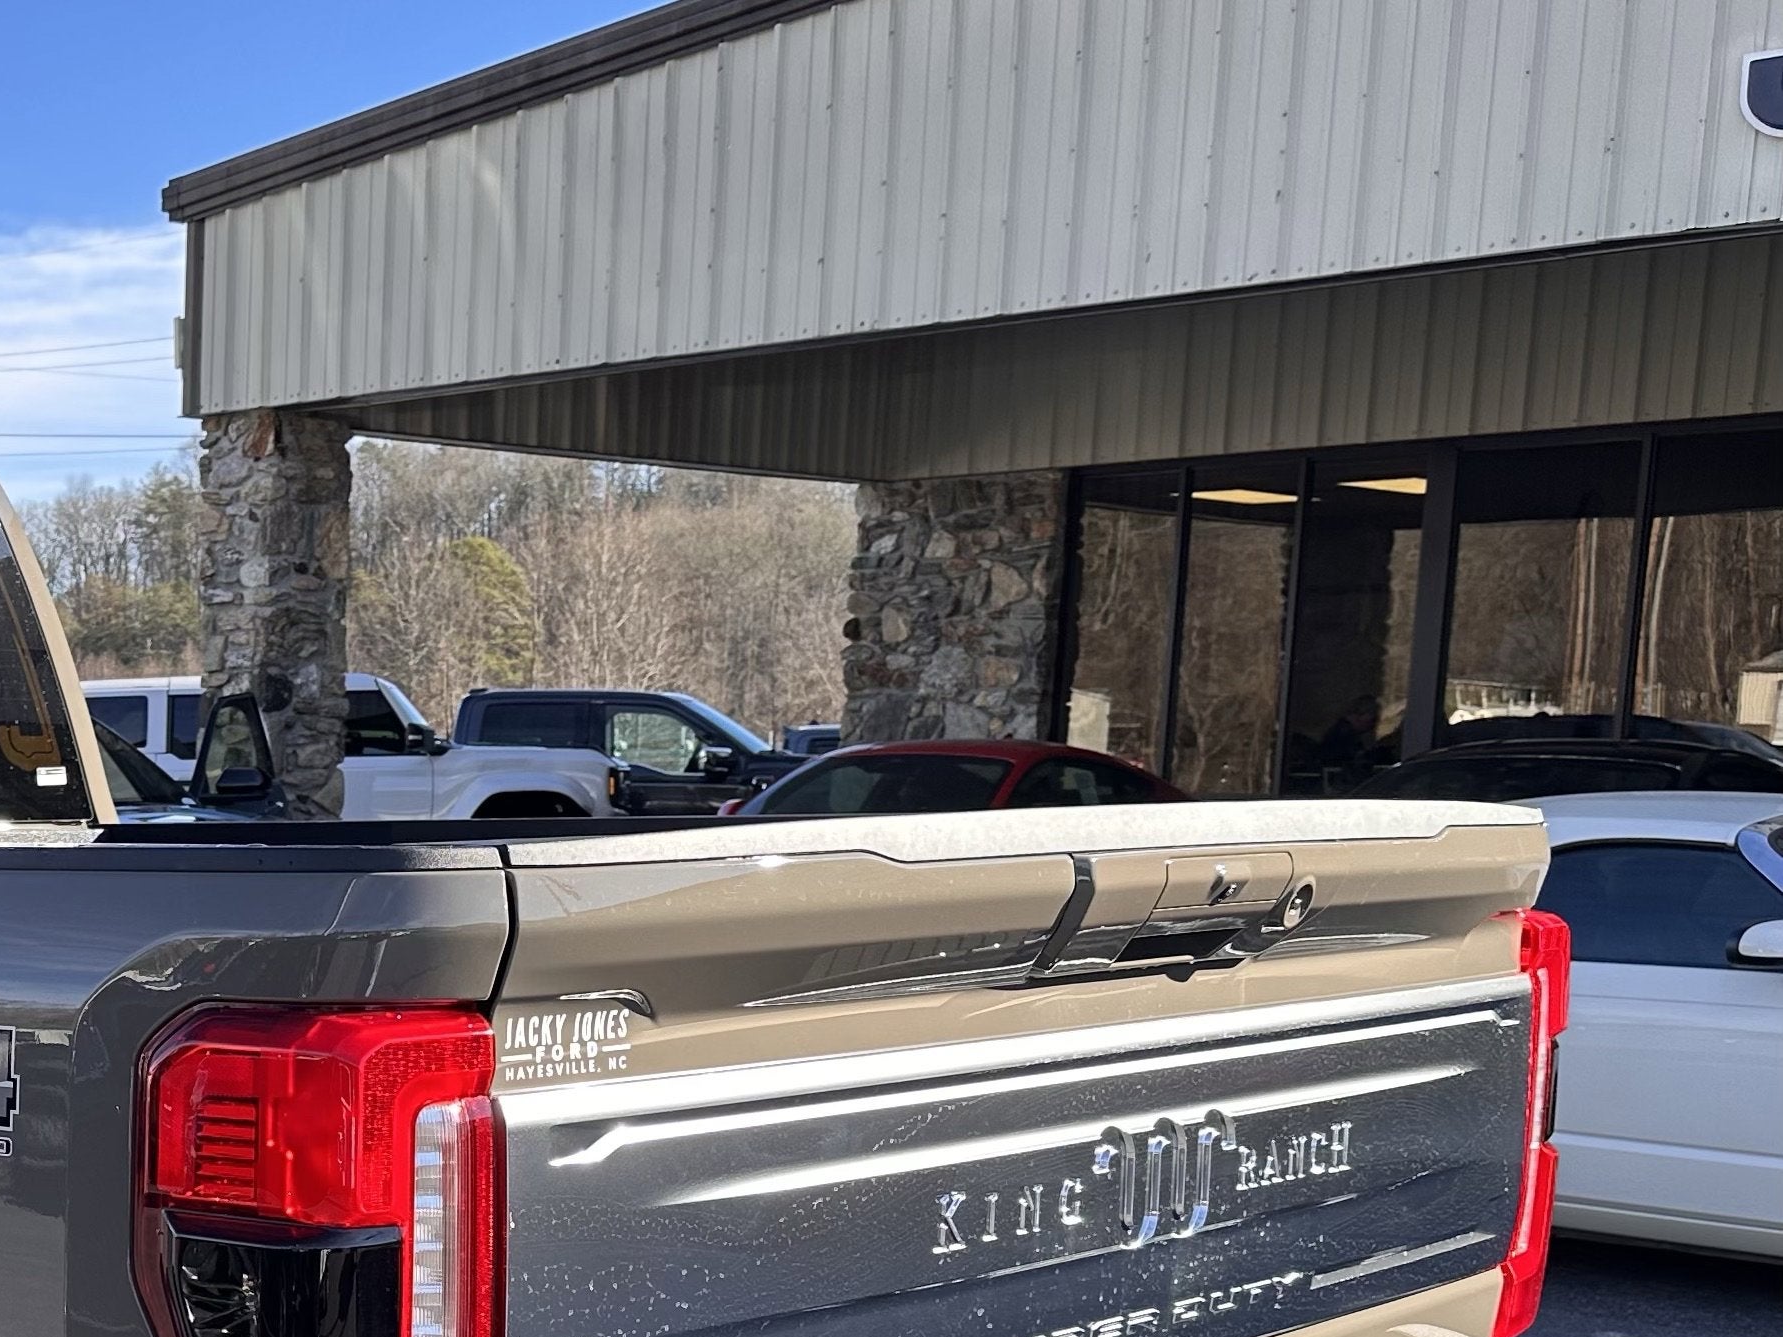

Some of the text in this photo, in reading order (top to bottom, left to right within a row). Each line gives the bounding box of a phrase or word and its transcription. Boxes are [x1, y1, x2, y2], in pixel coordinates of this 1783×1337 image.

[505, 1009, 630, 1050] JACKY JONES
[535, 1041, 598, 1064] FORD
[608, 1055, 628, 1070] NC
[932, 1120, 1353, 1254] KING RANCH
[1172, 1271, 1302, 1323] DUTY
